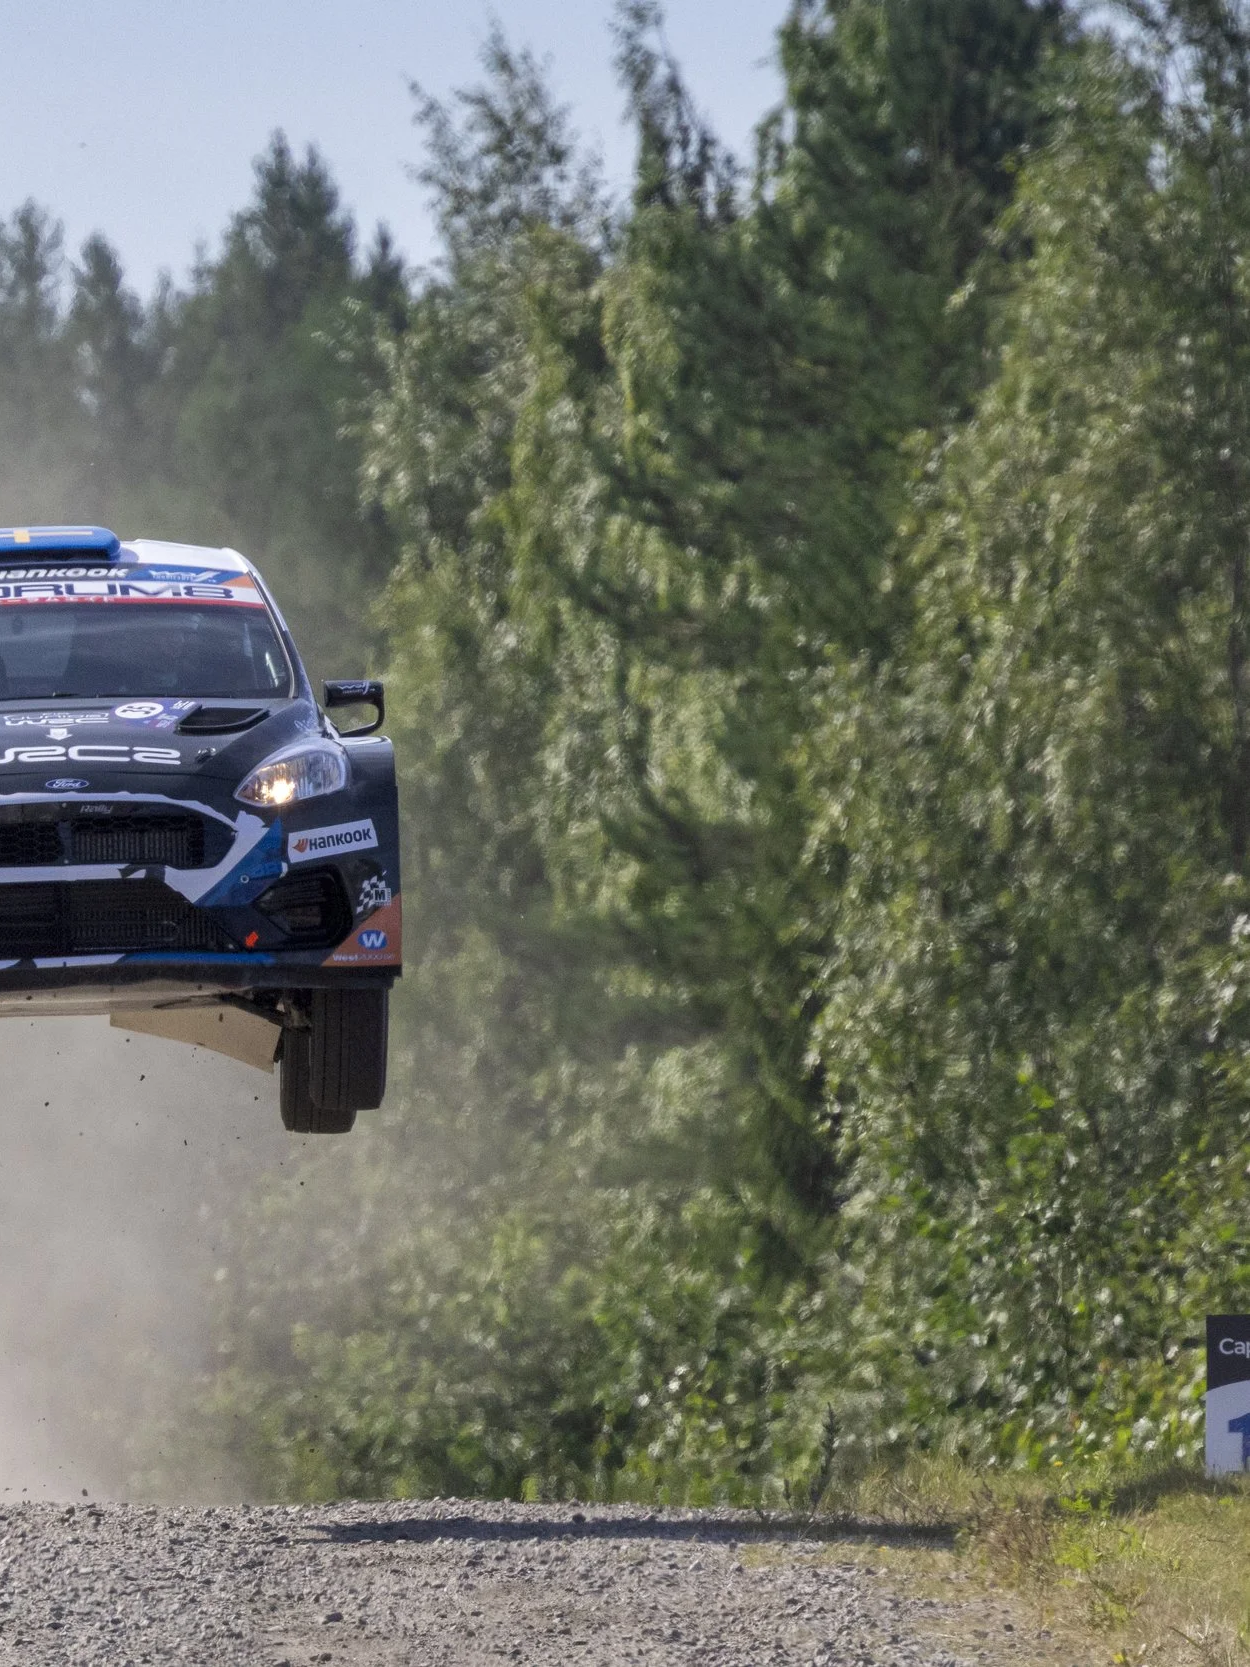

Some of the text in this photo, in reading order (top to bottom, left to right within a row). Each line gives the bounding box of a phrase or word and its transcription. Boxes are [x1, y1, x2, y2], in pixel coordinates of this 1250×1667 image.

[51, 779, 83, 788] Ford
[80, 804, 114, 815] Rally
[374, 889, 386, 901] M
[361, 931, 386, 948] W
